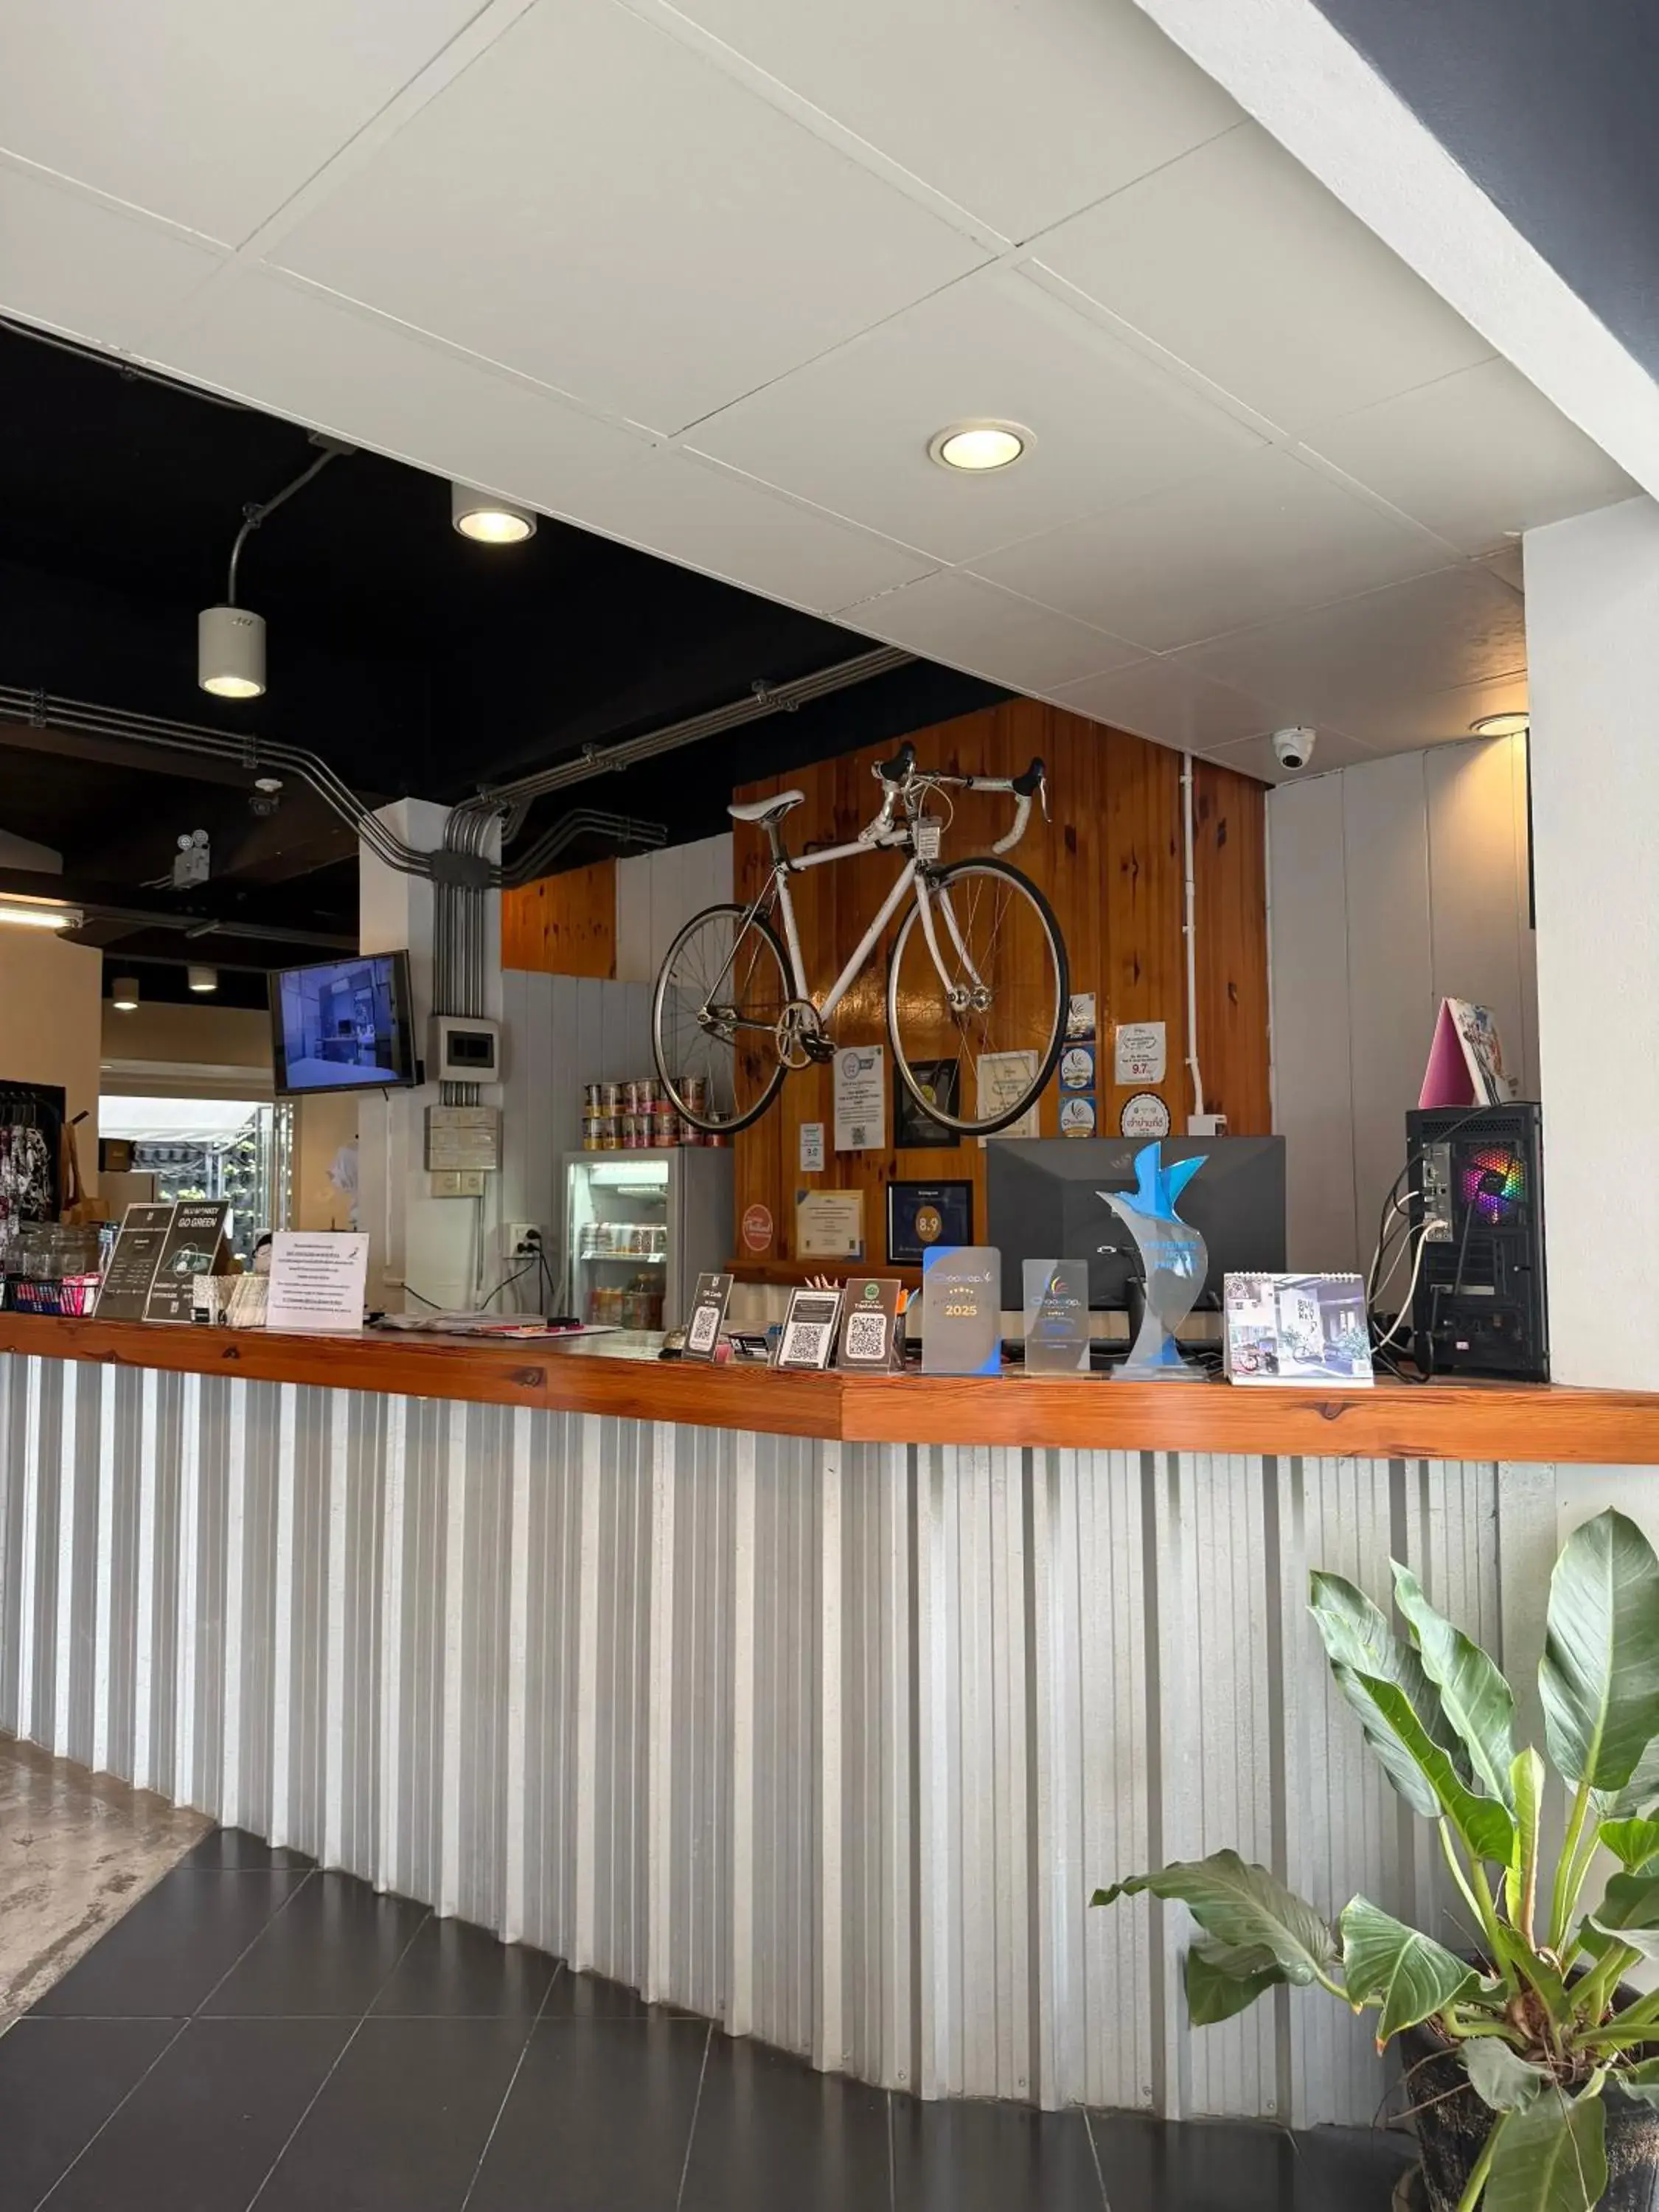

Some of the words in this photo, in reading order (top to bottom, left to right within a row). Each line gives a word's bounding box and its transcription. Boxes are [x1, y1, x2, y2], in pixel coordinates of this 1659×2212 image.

[191, 1217, 218, 1228] GREEN
[919, 1217, 938, 1231] 8.9
[946, 1305, 977, 1316] 2025
